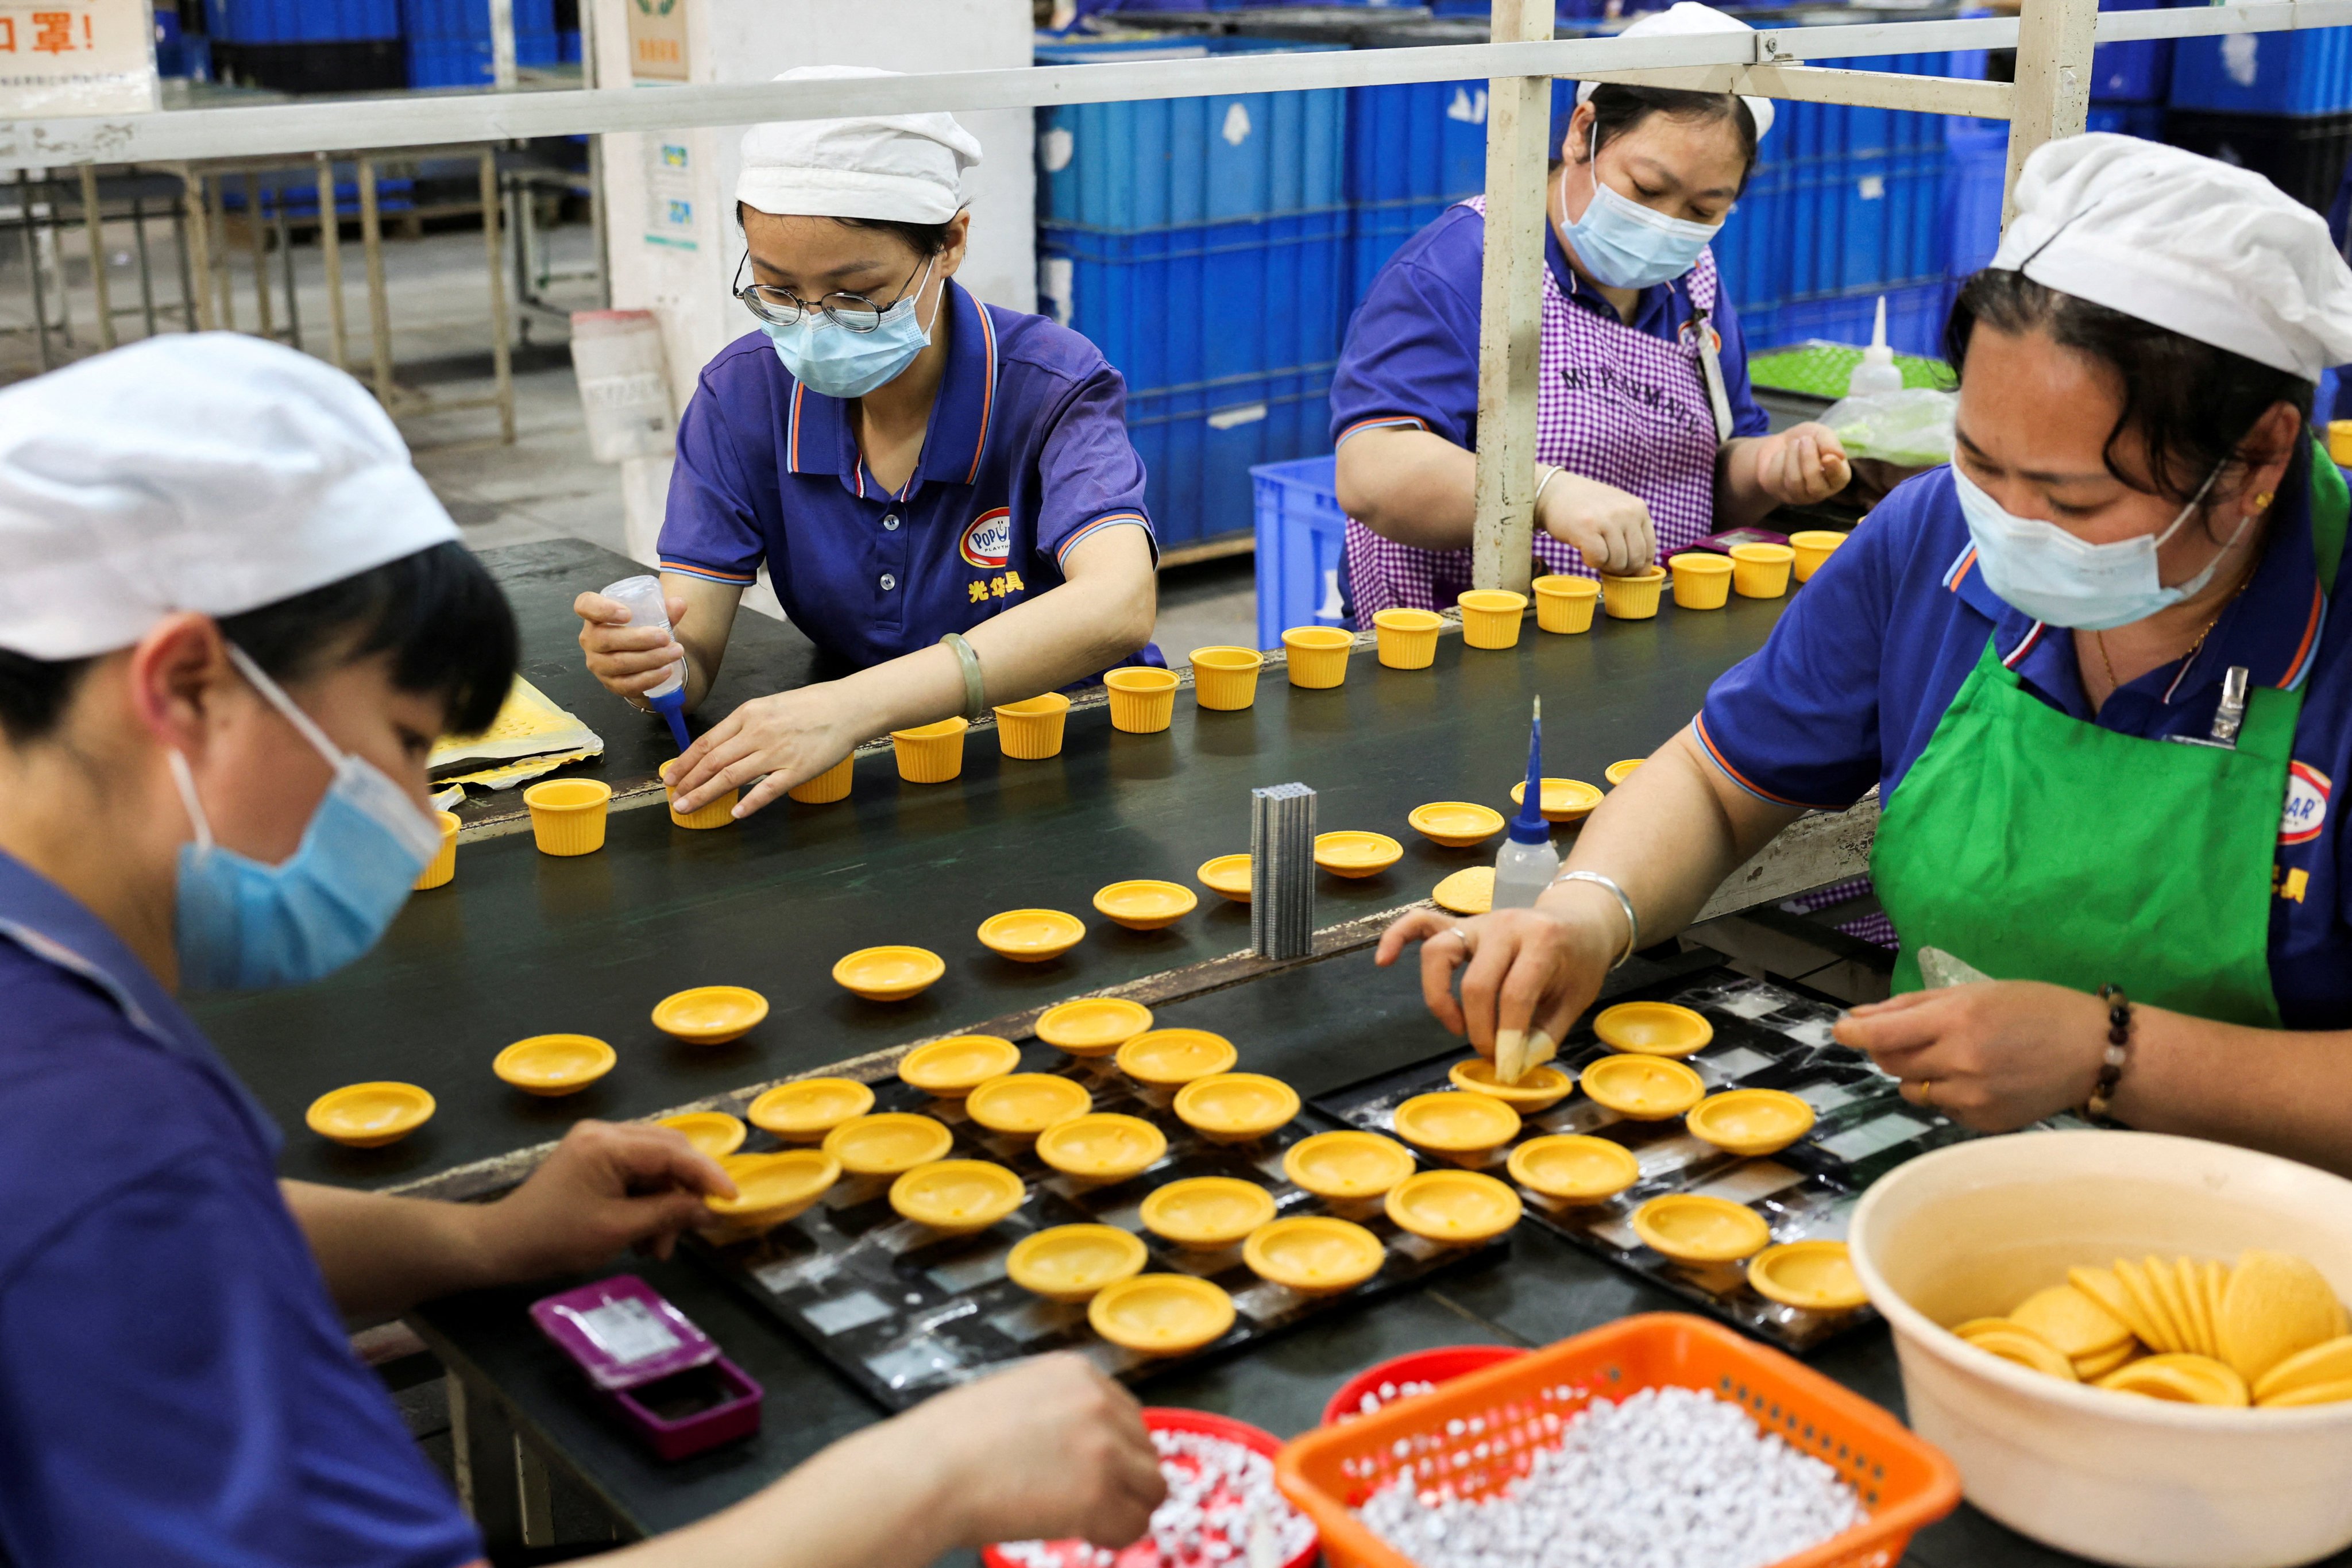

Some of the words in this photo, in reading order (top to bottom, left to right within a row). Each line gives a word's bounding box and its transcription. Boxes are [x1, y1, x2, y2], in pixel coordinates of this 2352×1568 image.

[1600, 367, 1701, 434] PAYMATE
[972, 526, 1010, 549] POPU
[2284, 793, 2315, 820] AR
